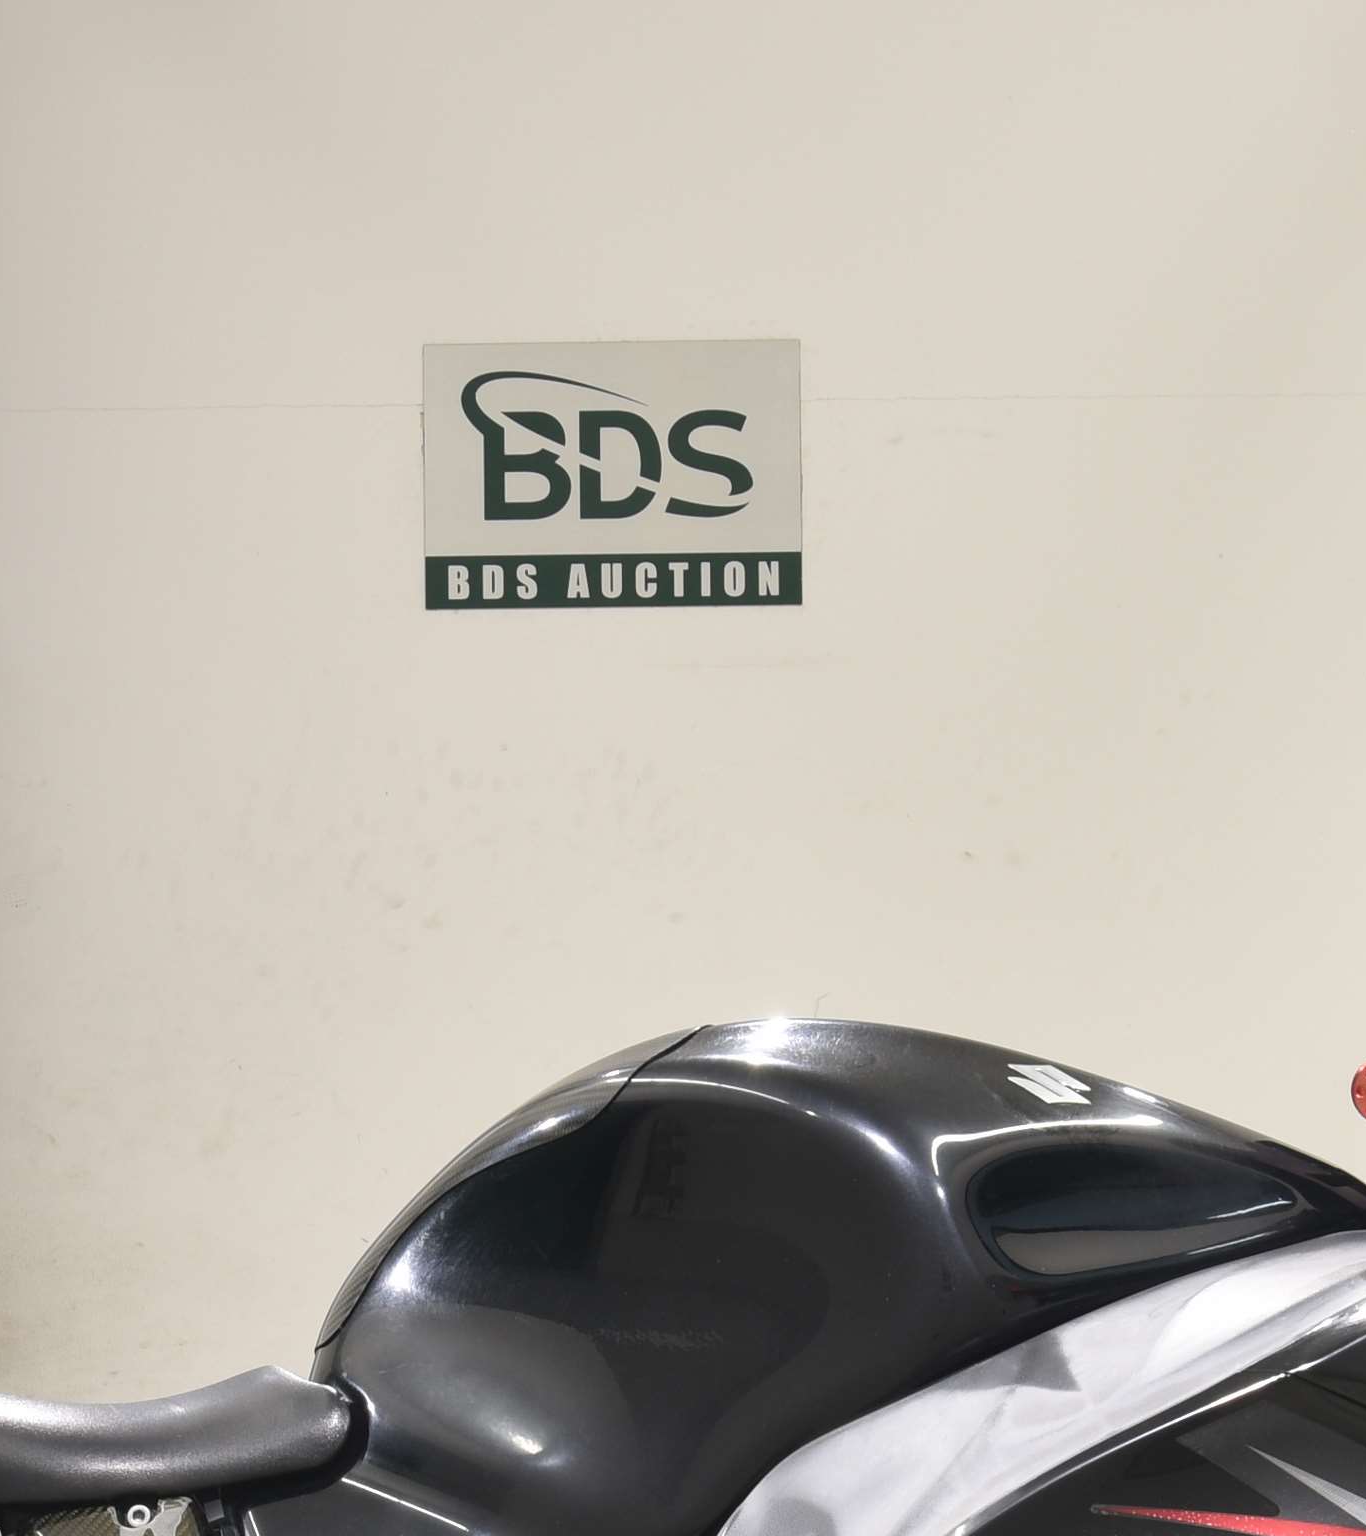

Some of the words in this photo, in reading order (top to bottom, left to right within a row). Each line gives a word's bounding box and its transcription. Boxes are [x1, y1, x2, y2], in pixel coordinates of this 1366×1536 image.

[460, 371, 754, 521] BDS
[447, 563, 539, 600] BDS
[566, 560, 781, 599] AUCTION
